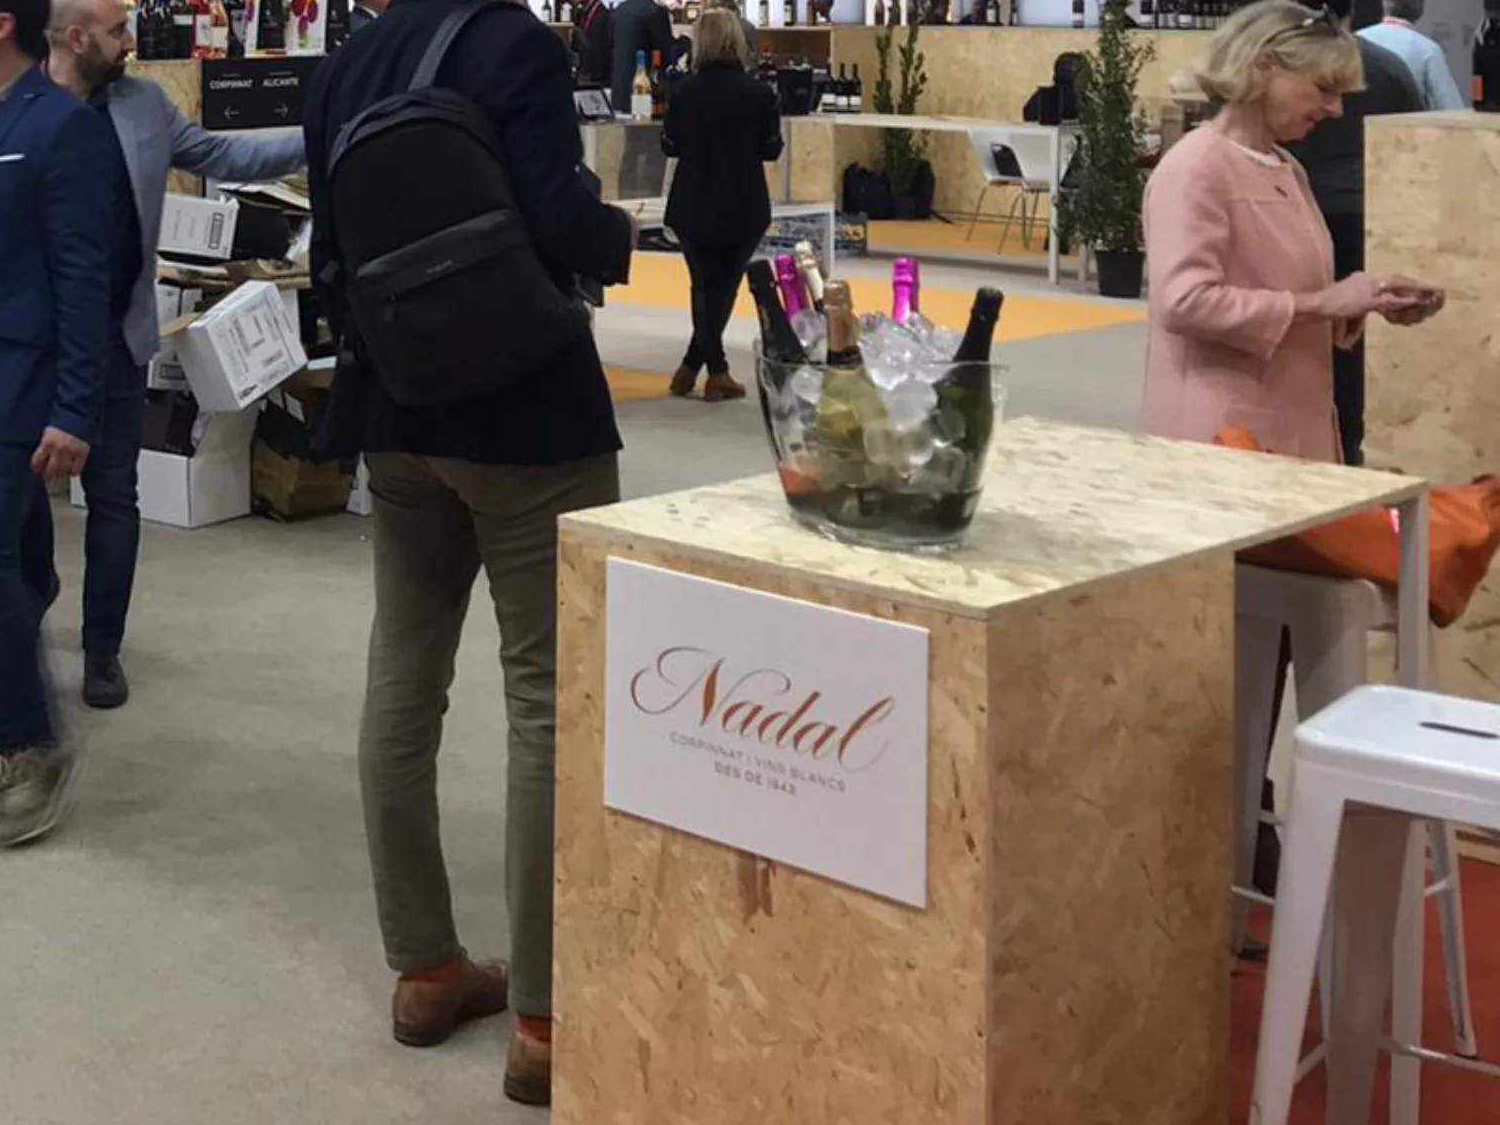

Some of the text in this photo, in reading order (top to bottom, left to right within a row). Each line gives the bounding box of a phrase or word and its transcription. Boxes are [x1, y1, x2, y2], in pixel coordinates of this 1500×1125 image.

[630, 645, 895, 774] Nadal
[669, 730, 743, 762] CORPINNAT
[754, 755, 787, 776] VINS
[789, 767, 847, 794] BLANCS
[714, 760, 742, 780] DES
[744, 769, 764, 787] DE
